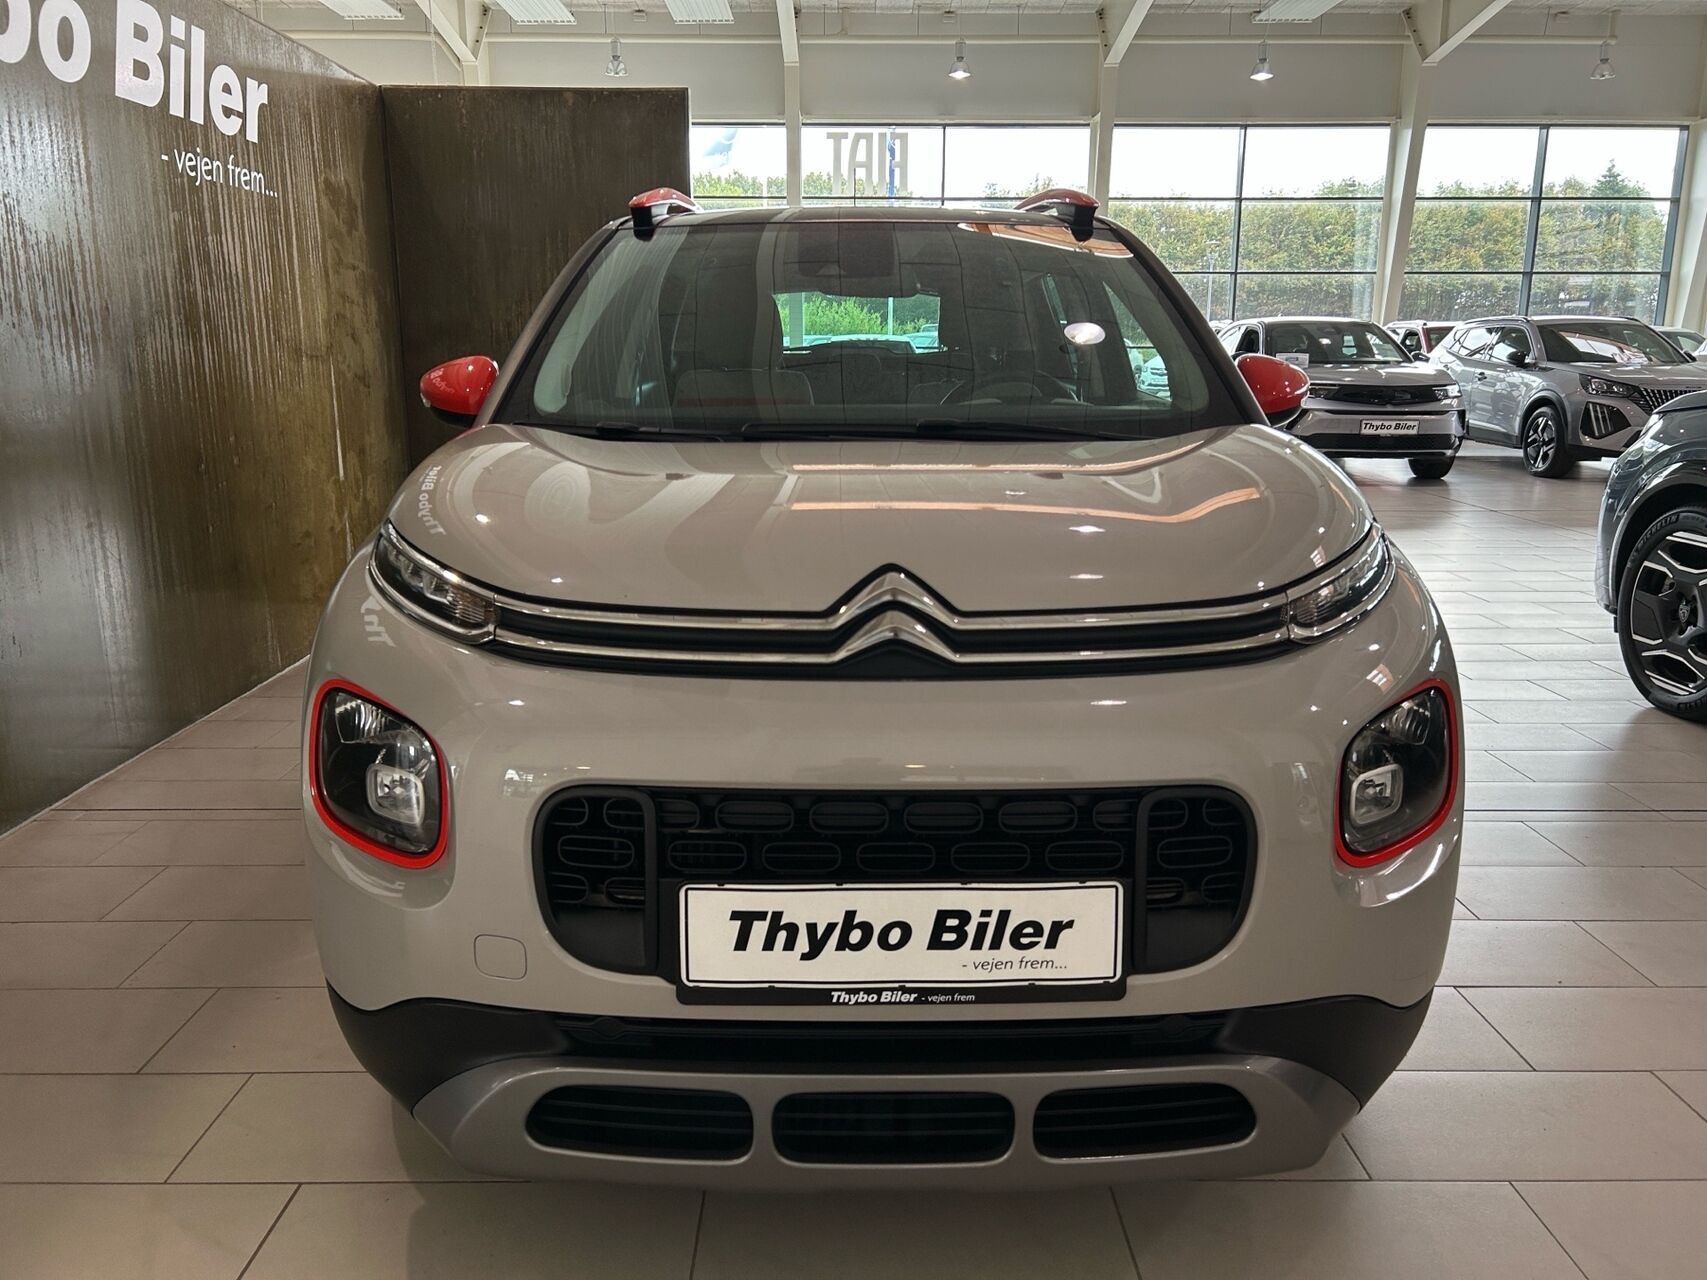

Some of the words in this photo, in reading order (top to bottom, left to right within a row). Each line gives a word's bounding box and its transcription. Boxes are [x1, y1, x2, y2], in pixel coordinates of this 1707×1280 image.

[115, 0, 268, 143] Biler
[174, 147, 223, 186] vejen
[228, 154, 278, 198] frem...
[1363, 422, 1393, 432] Thybo
[1394, 422, 1417, 431] Biler
[728, 909, 913, 961] Thybo
[926, 909, 1075, 951] Biler
[973, 957, 1014, 974] vejen
[1018, 955, 1067, 970] frem...
[831, 990, 878, 1005] Thybo
[880, 990, 918, 1003] Biler
[927, 994, 951, 1004] vejen
[953, 992, 976, 1002] frem
